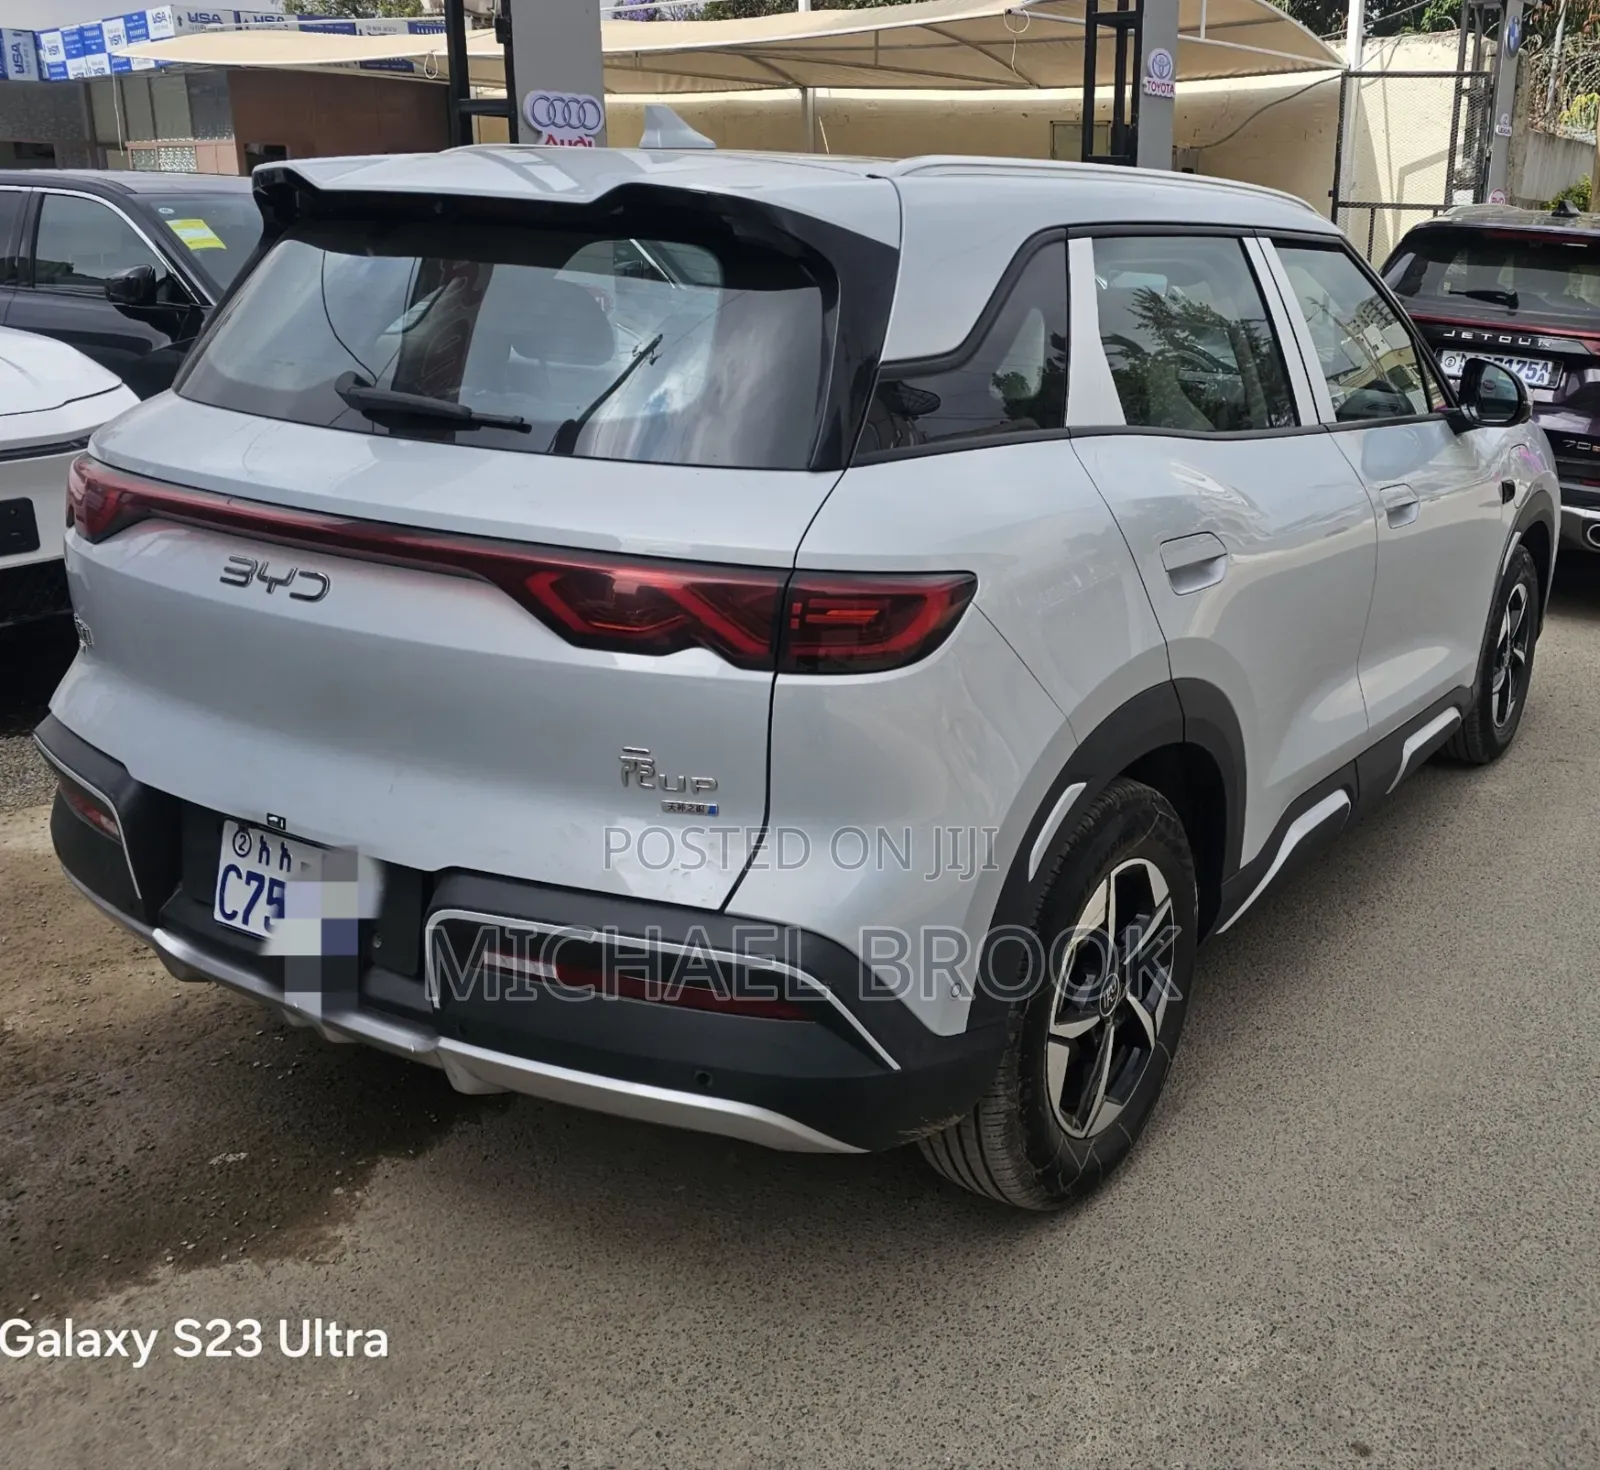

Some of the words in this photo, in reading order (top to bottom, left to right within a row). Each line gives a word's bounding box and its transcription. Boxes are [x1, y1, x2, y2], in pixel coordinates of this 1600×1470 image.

[152, 12, 167, 24] USA
[187, 12, 223, 24] USA
[11, 42, 25, 75] USA
[1147, 80, 1175, 95] TOYOTA
[1443, 330, 1552, 348] JETOUR
[219, 554, 331, 603] BYD
